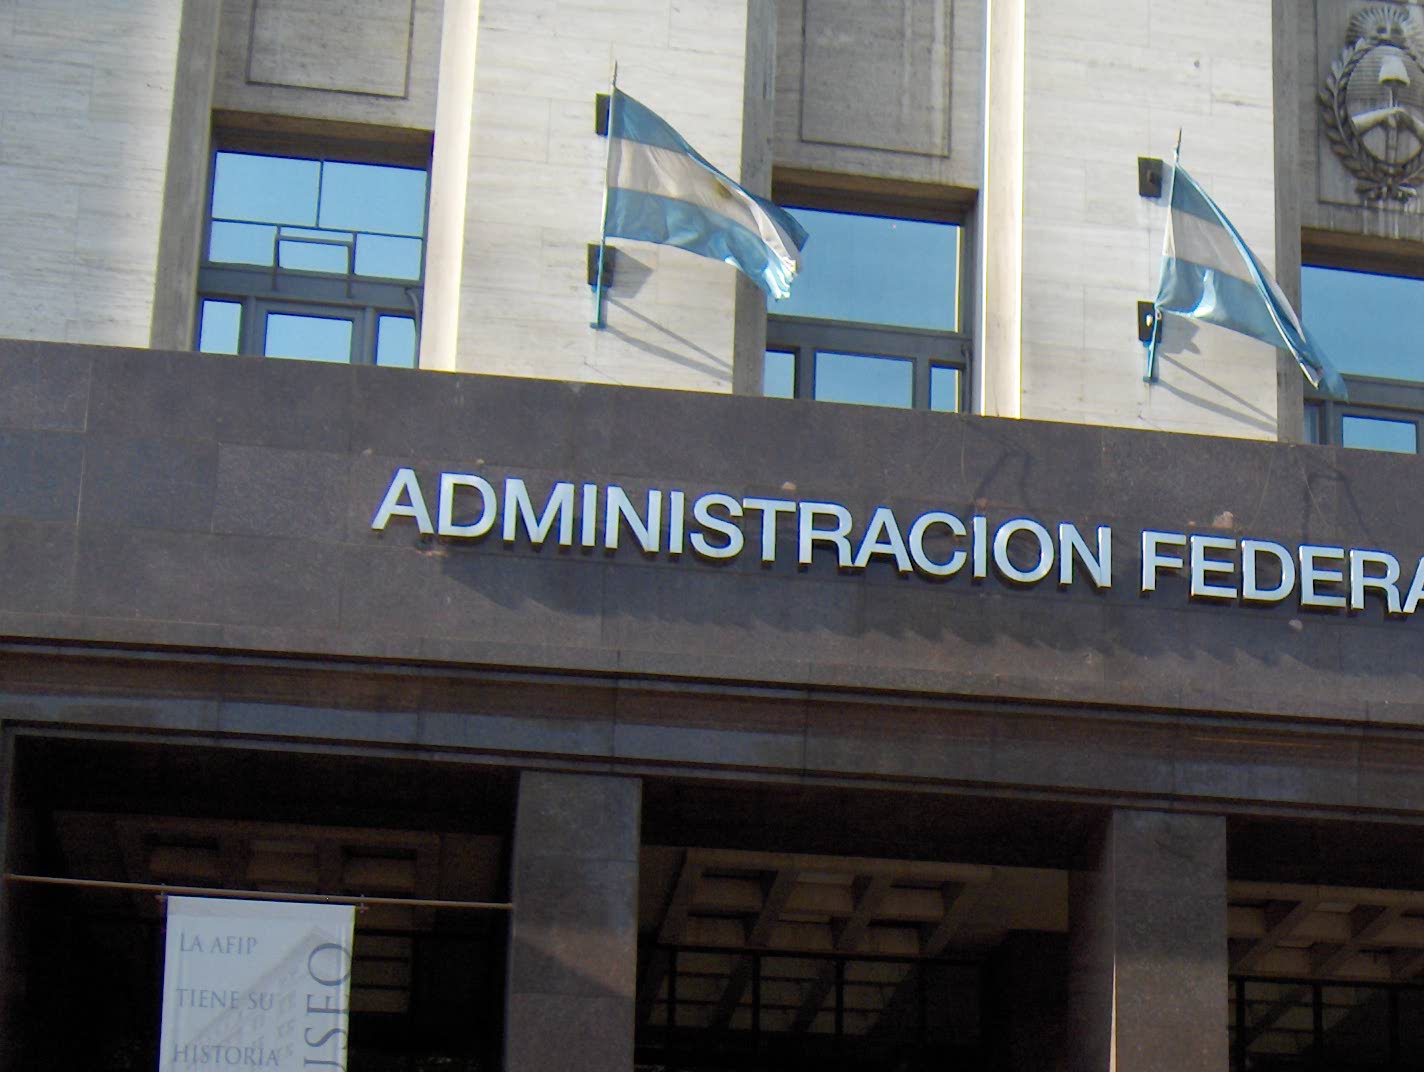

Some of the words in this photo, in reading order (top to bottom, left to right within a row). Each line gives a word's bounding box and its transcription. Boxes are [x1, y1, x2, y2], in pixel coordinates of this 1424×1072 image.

[371, 467, 1112, 588] ADMINISTRACION
[180, 932, 204, 952] LA
[211, 935, 257, 954] AFIP
[176, 988, 240, 1010] TIENE
[247, 993, 274, 1012] SU
[172, 1043, 280, 1067] HISTORIA
